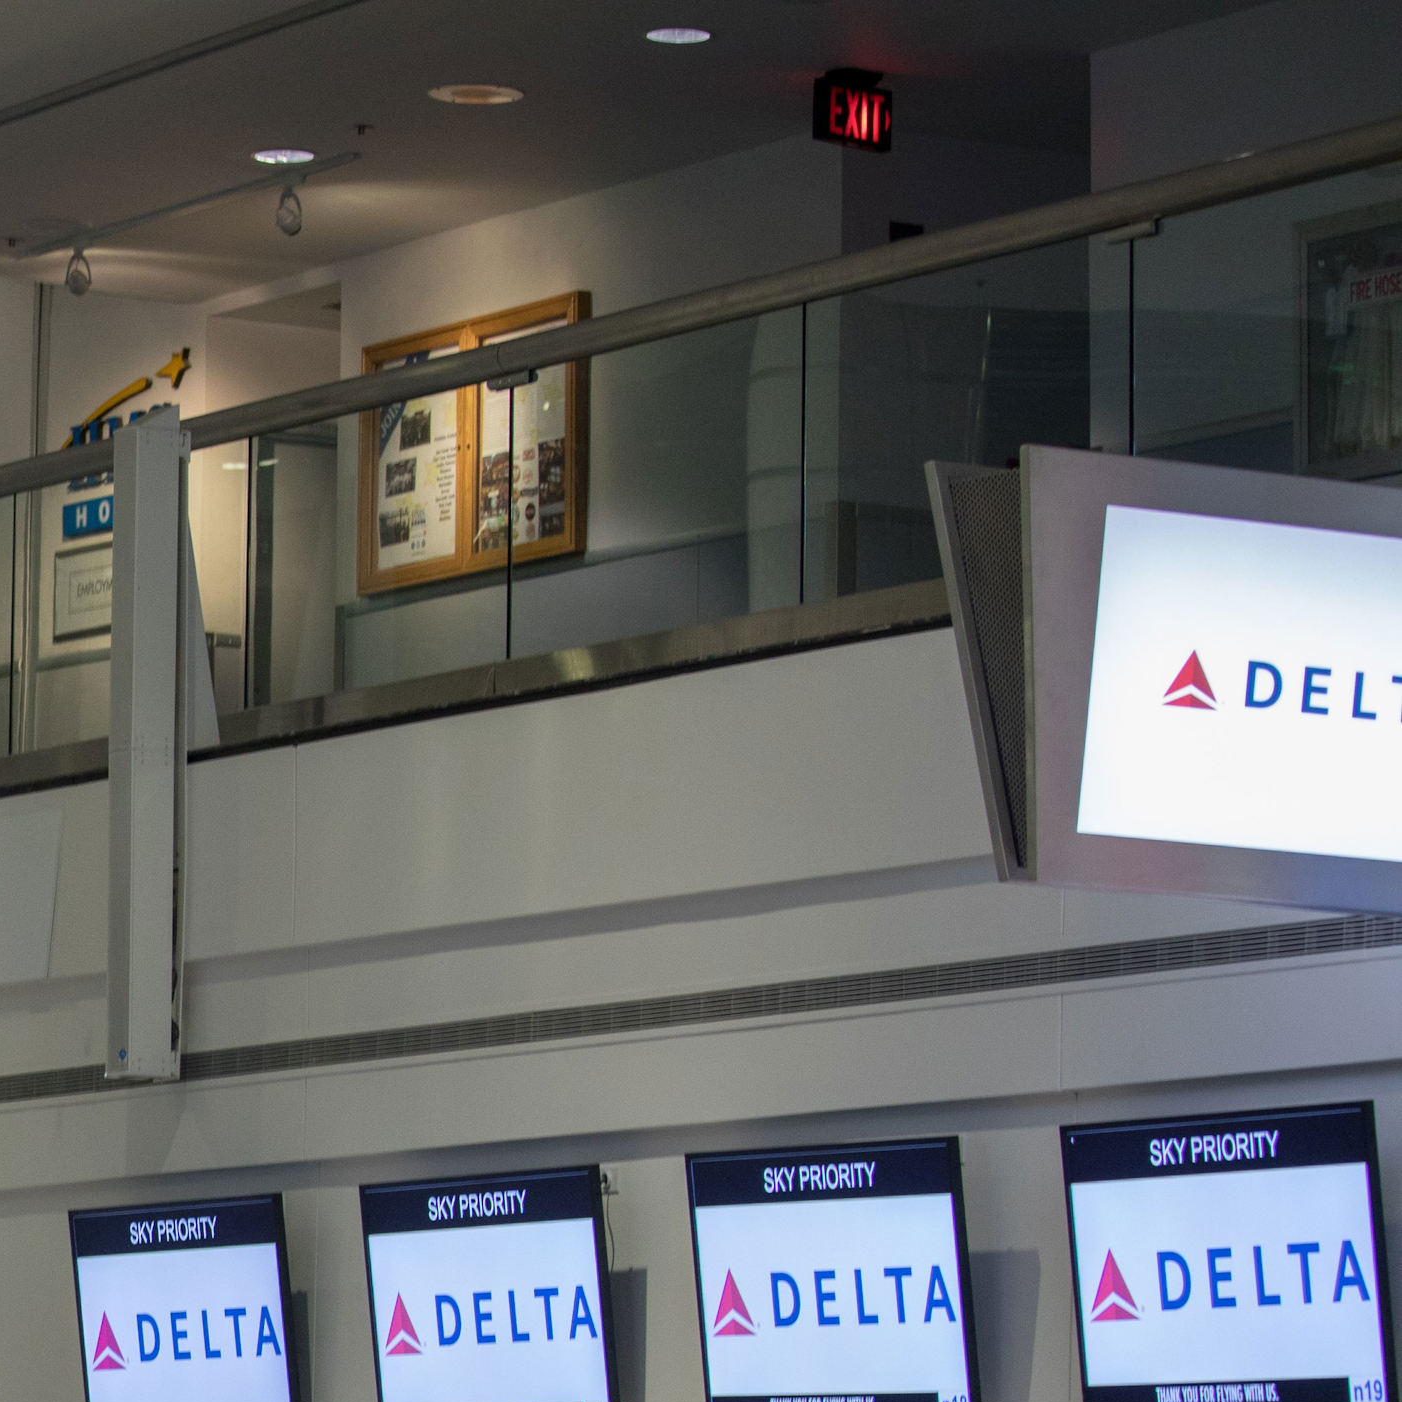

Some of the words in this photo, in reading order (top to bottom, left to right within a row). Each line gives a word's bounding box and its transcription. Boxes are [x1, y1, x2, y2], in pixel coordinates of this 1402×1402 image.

[829, 86, 885, 143] EXIT
[1149, 1137, 1187, 1167] SKY
[1190, 1130, 1280, 1163] PRIORITY
[763, 1167, 796, 1194] SKY
[799, 1161, 876, 1191] PRIORITY
[427, 1196, 456, 1223] SKY
[458, 1190, 527, 1219] PRIORITY
[129, 1220, 155, 1246] SKY
[157, 1215, 218, 1243] PRIORITY
[1156, 1240, 1371, 1312] DELTA
[769, 1265, 957, 1327] DELTA
[434, 1285, 598, 1346] DELTA
[136, 1306, 282, 1363] DELTA
[1216, 1384, 1243, 1402] FLYING
[1244, 1383, 1264, 1402] WITH
[1265, 1383, 1279, 1401] US.
[1353, 1378, 1383, 1402] n19
